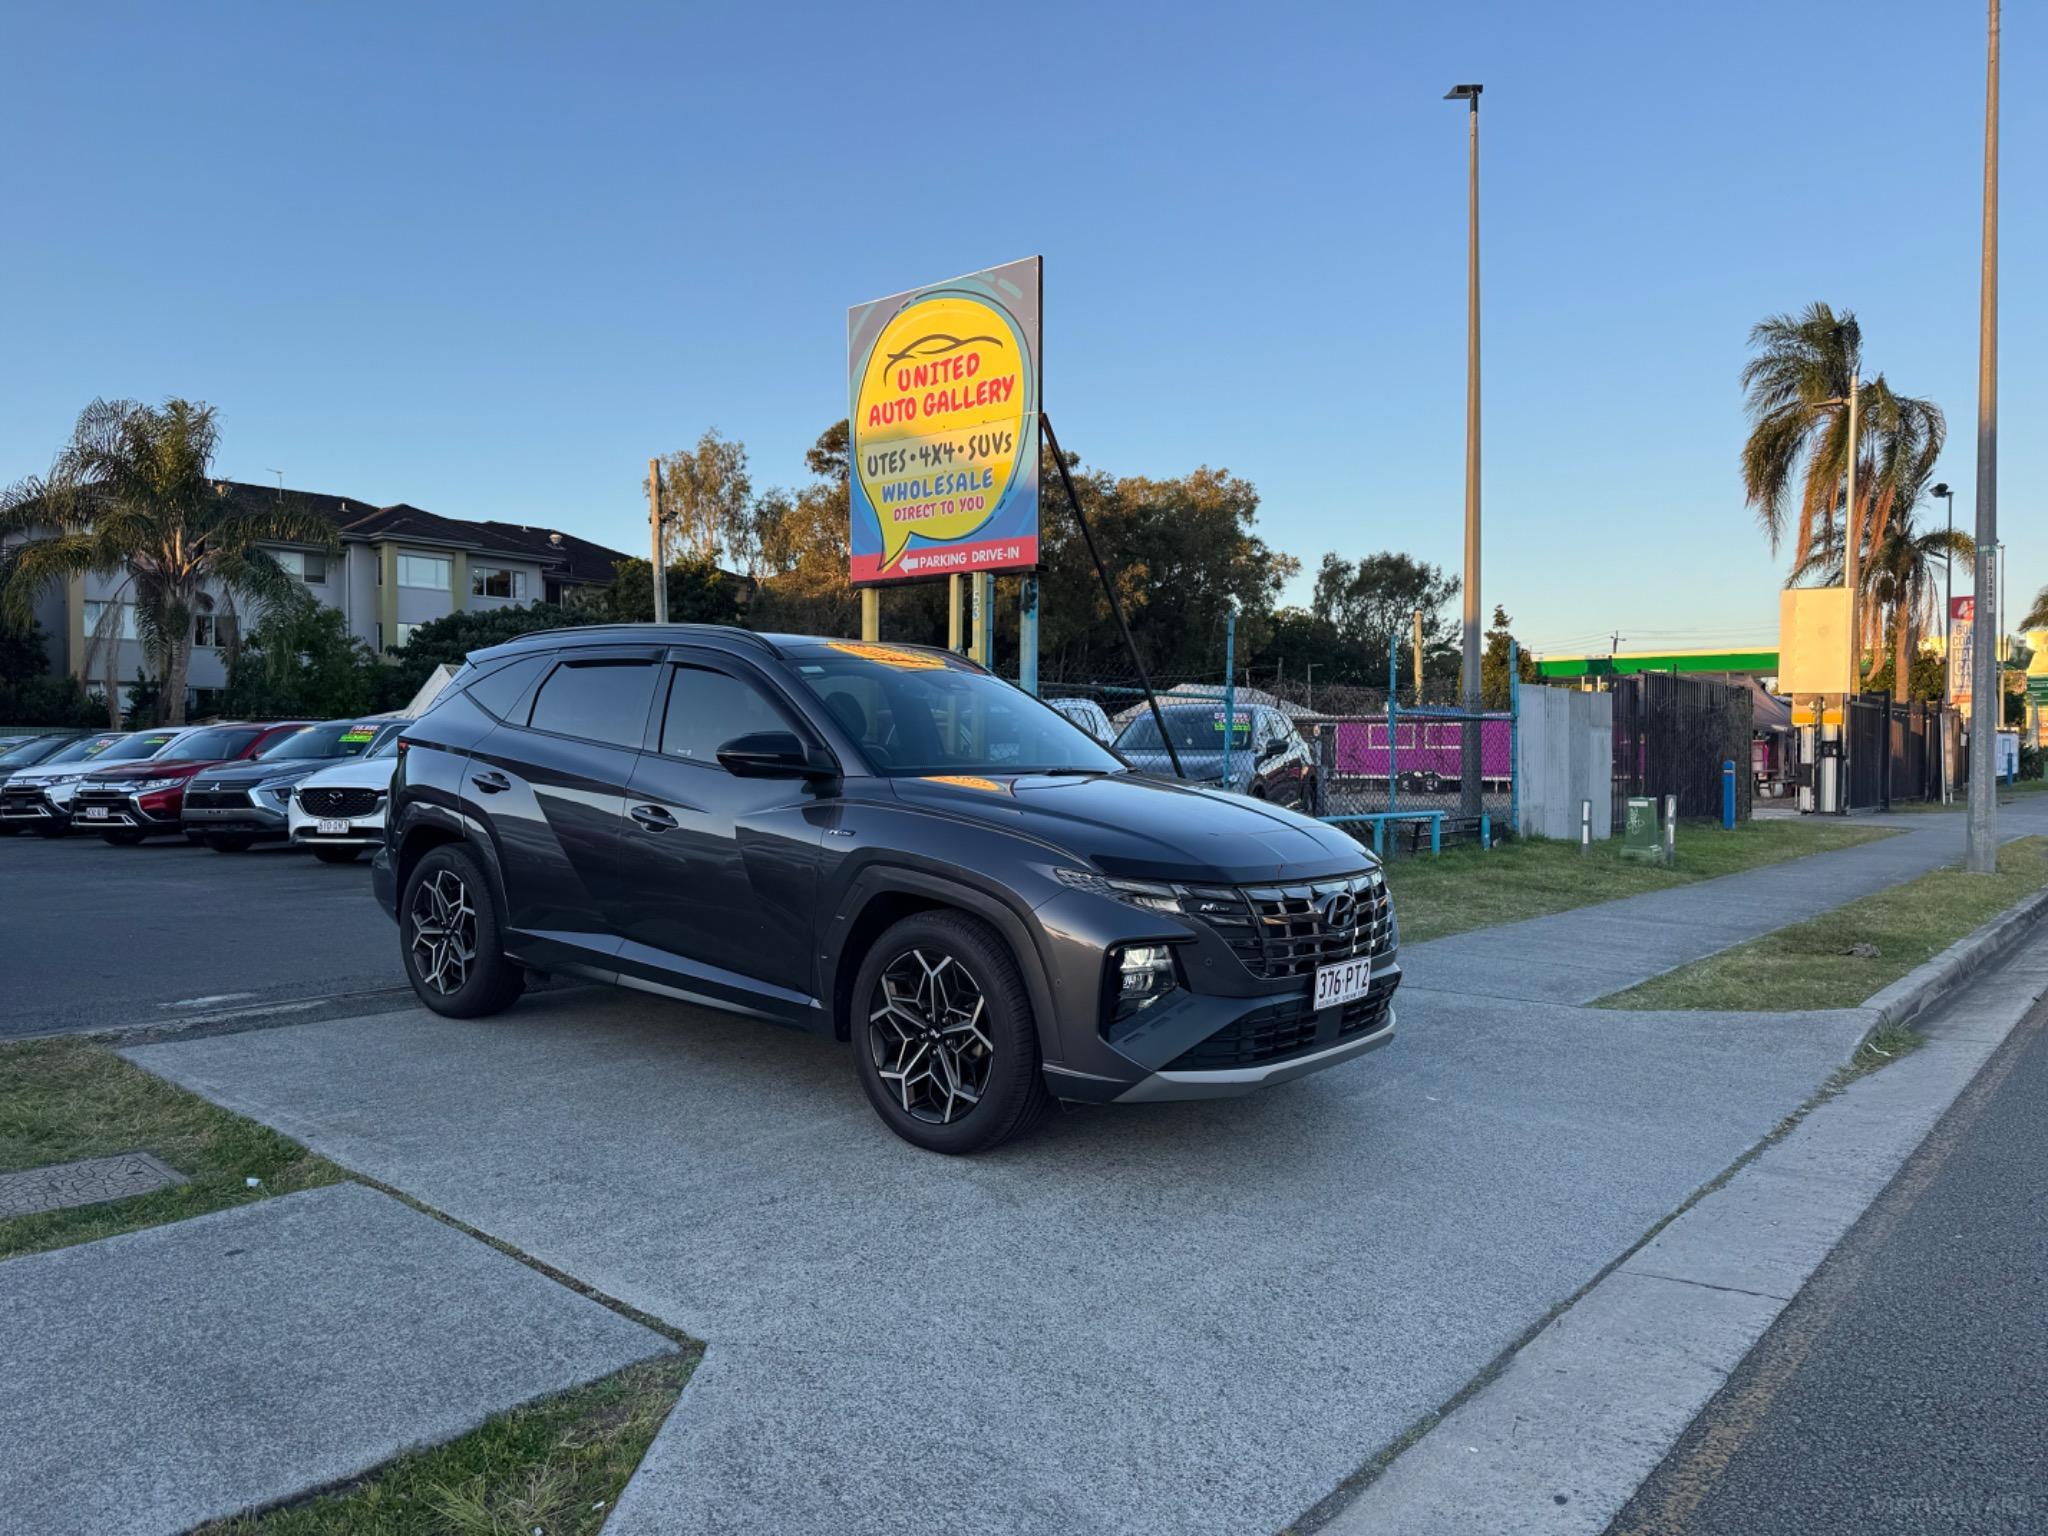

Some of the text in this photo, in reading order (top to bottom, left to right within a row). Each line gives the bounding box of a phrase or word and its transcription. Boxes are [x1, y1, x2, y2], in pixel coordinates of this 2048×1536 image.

[898, 352, 980, 392] UNITED
[869, 374, 1015, 427] AUTO GALLERY
[867, 448, 906, 477] UTES
[919, 441, 955, 467] 4X4
[882, 467, 993, 503] WHOLESALE
[894, 495, 985, 522] DIRECT TO YOU
[920, 546, 1019, 569] PARKING DRIVE-IN
